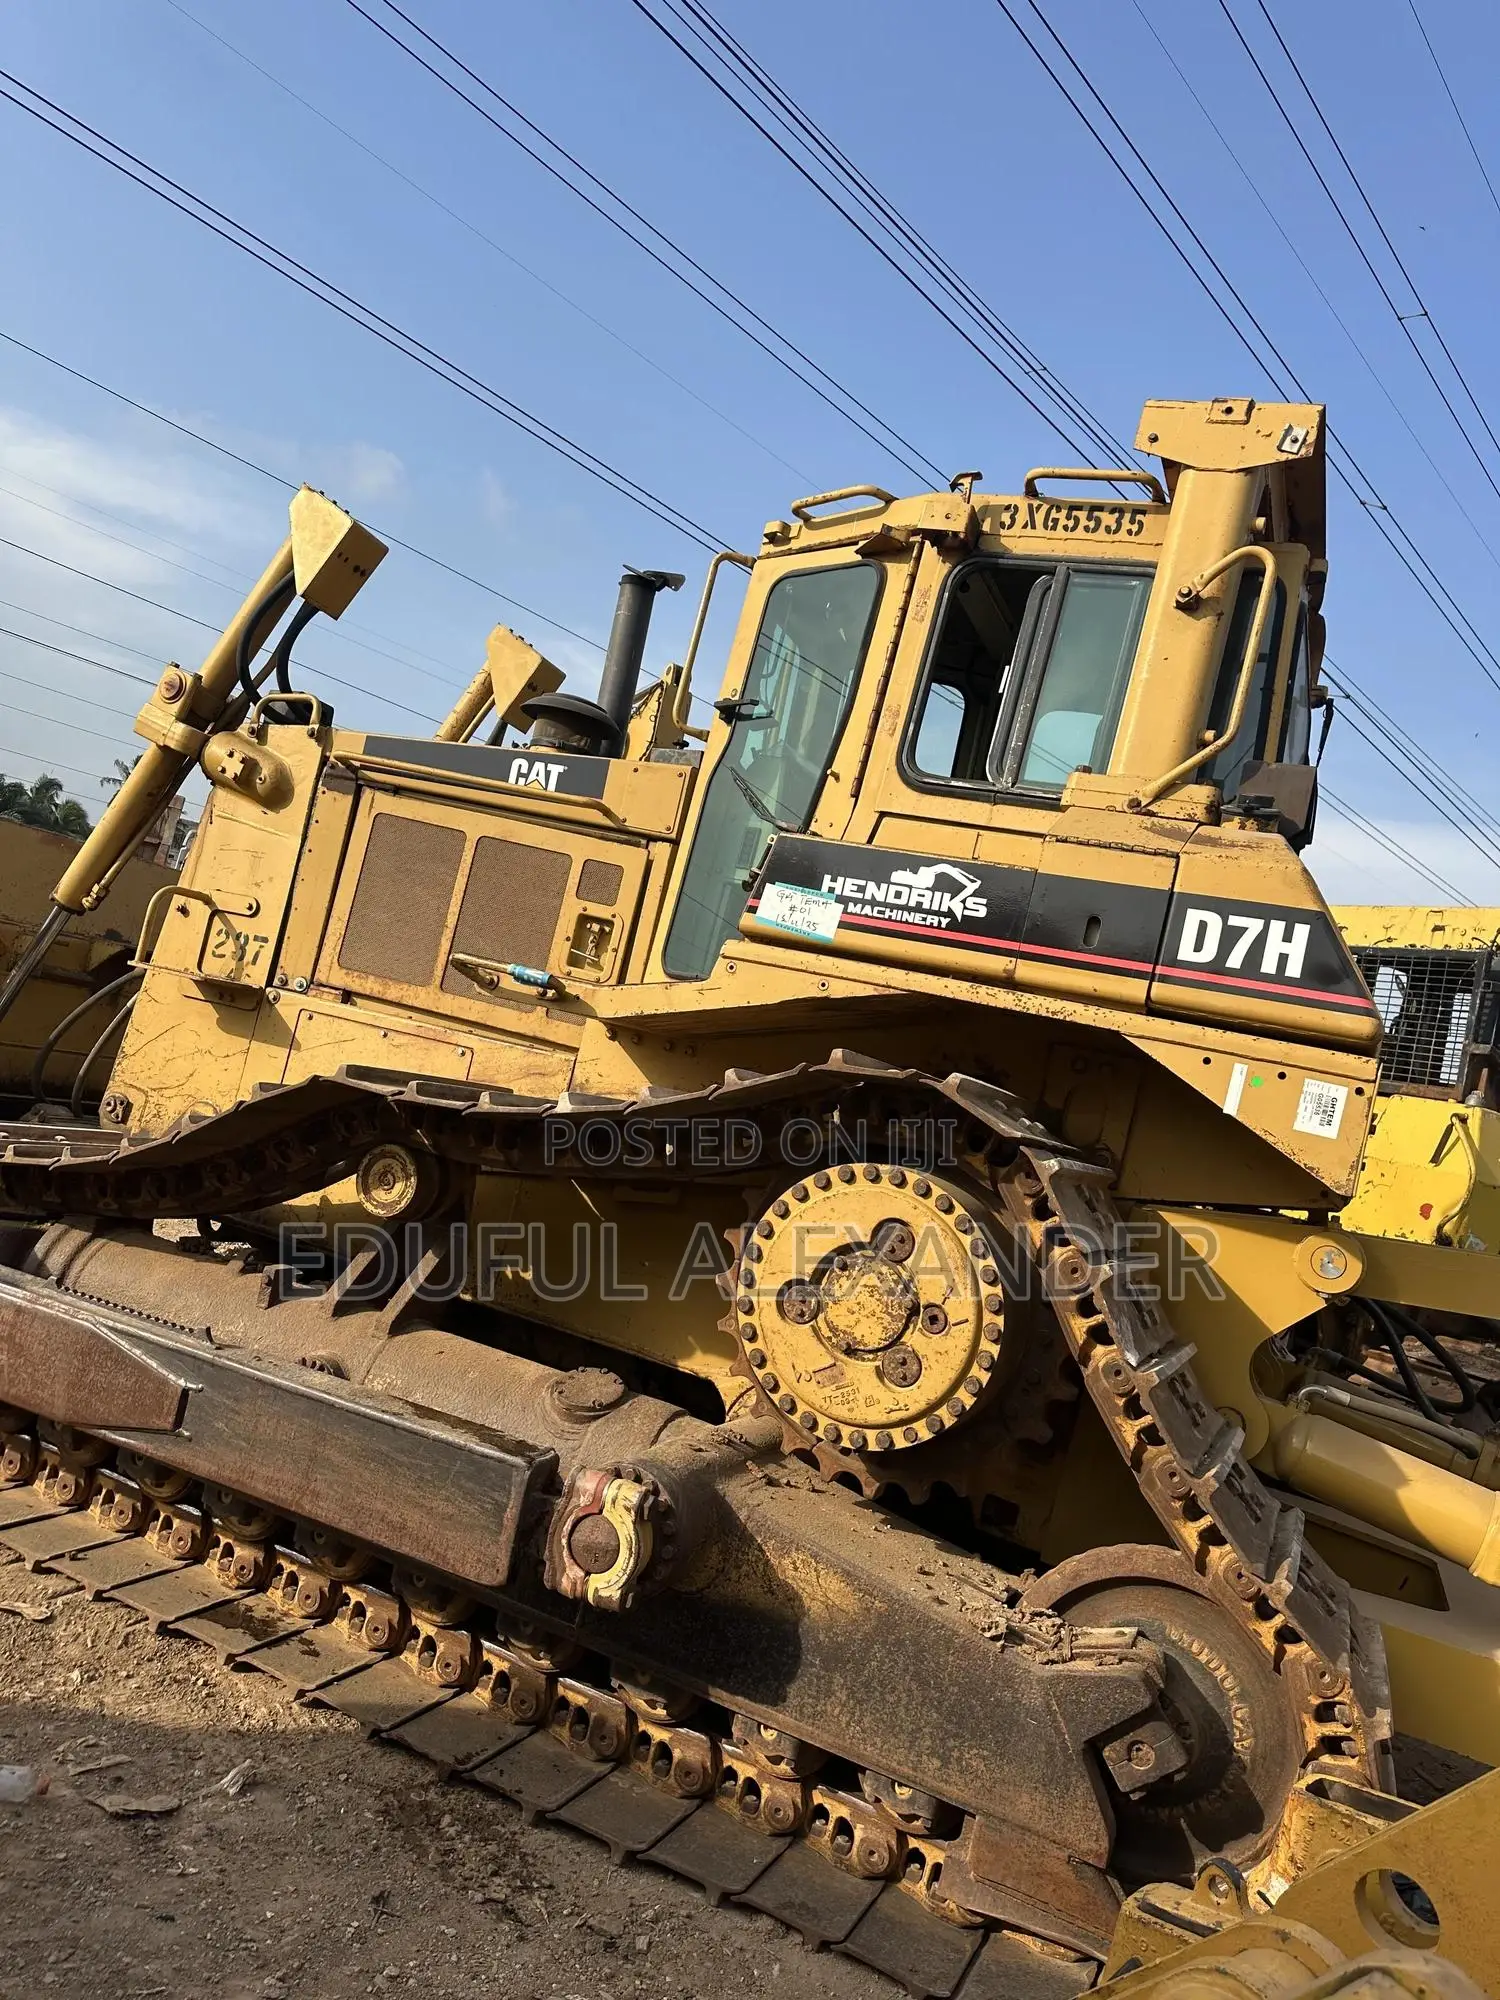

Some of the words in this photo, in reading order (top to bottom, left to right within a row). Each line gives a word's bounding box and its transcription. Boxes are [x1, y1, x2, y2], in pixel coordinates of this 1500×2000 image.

[1000, 503, 1148, 537] 3XG5535
[507, 757, 564, 793] CAT
[820, 874, 988, 922] HENDRIKS
[847, 903, 952, 929] MACHINERY
[1176, 907, 1312, 979] D7H
[1325, 1096, 1338, 1127] GHTEM
